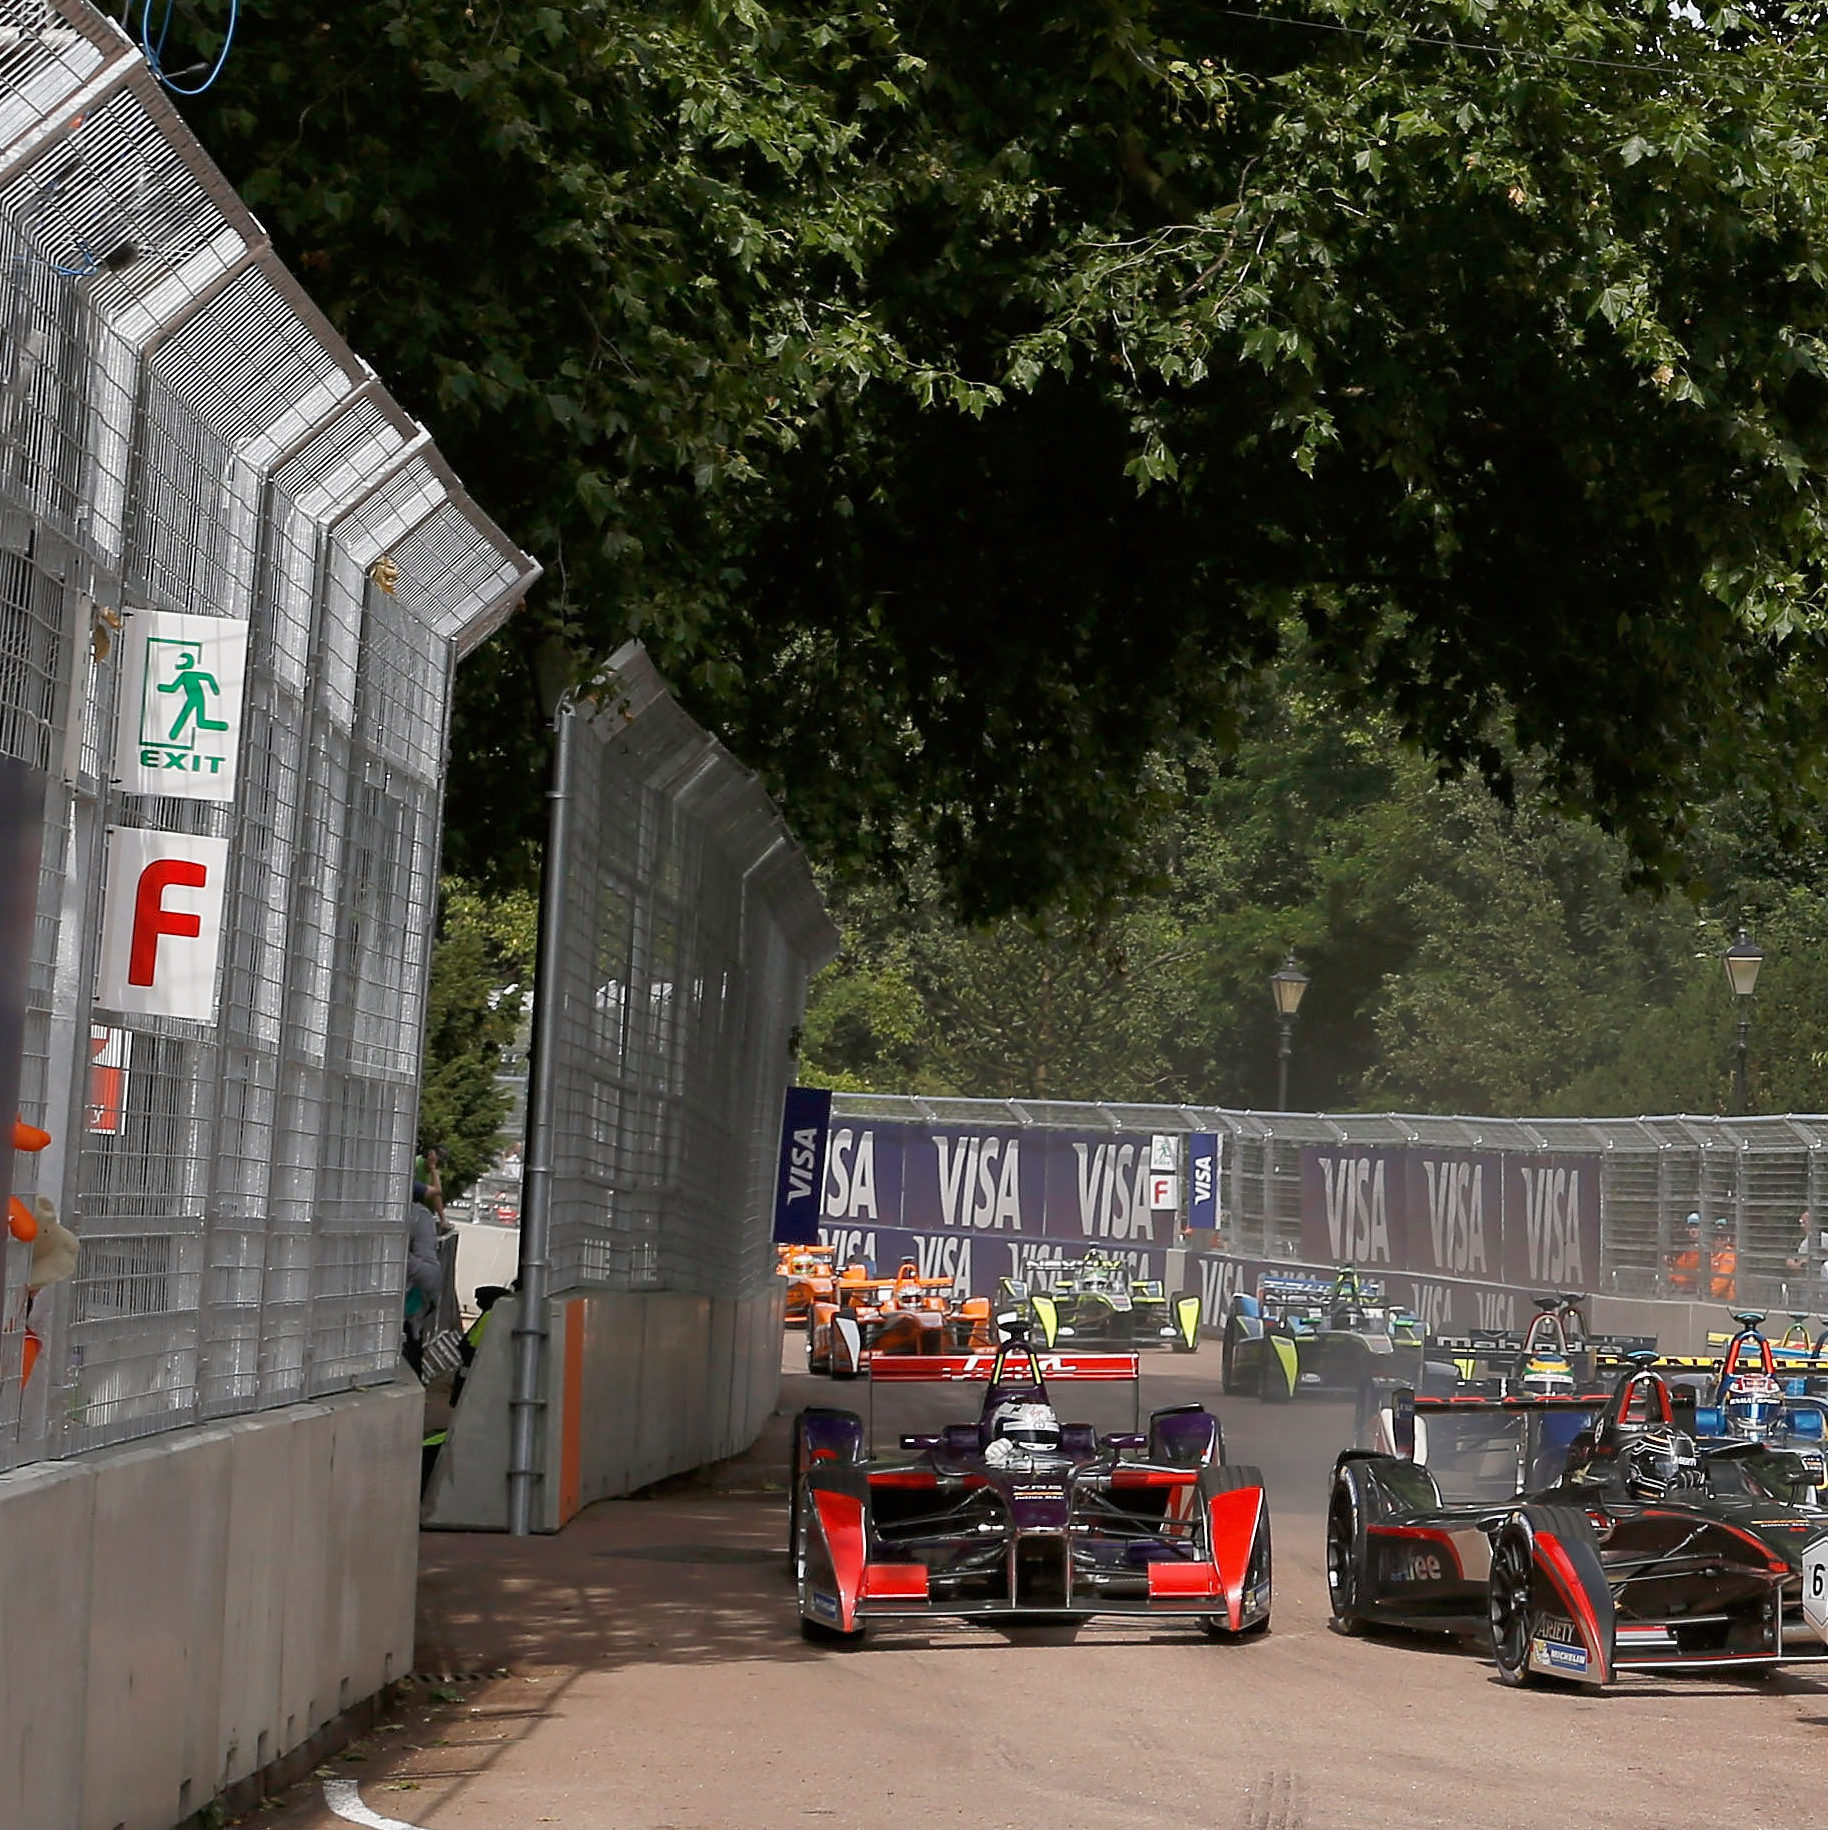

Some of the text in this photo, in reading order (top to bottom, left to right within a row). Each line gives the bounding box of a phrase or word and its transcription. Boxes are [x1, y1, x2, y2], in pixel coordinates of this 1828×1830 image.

[140, 749, 227, 775] EXIT
[128, 858, 207, 987] F
[787, 1127, 818, 1206] VISA
[932, 1136, 1022, 1231] VISA
[1073, 1142, 1154, 1241] VISA
[1154, 1180, 1169, 1204] F
[1194, 1155, 1212, 1206] VISA
[1318, 1157, 1390, 1264] VISA
[1422, 1160, 1487, 1273] VISA
[1521, 1167, 1584, 1284] VISA
[913, 1235, 972, 1300] VISA
[1476, 1291, 1515, 1331] VISA
[1812, 1562, 1826, 1597] 6
